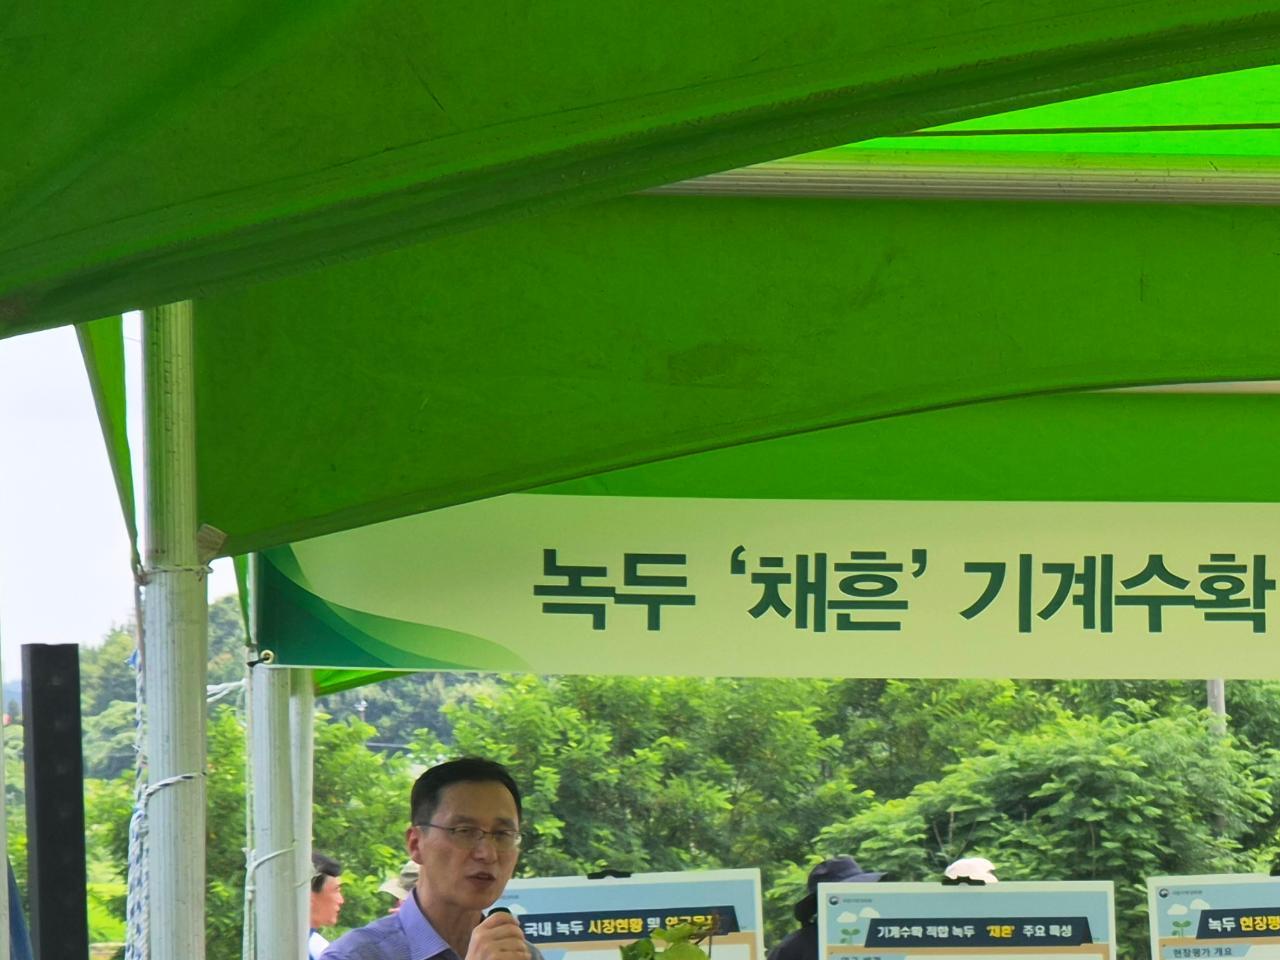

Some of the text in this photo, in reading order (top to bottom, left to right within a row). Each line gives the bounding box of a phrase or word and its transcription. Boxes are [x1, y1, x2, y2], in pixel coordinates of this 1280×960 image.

[533, 549, 696, 631] 녹두
[730, 545, 927, 632] '채흔'
[959, 553, 1276, 633] 기계수확
[524, 921, 552, 938] 국내
[556, 920, 584, 936] 녹두
[588, 917, 644, 935] 시장현황
[876, 926, 923, 938] 기계수확
[926, 926, 950, 938] 적합
[952, 925, 975, 938] 녹두
[1022, 925, 1046, 937] 주요
[1049, 924, 1073, 937] 특성
[1208, 917, 1236, 932] 녹두
[1173, 947, 1232, 958] 현장평가 개요
